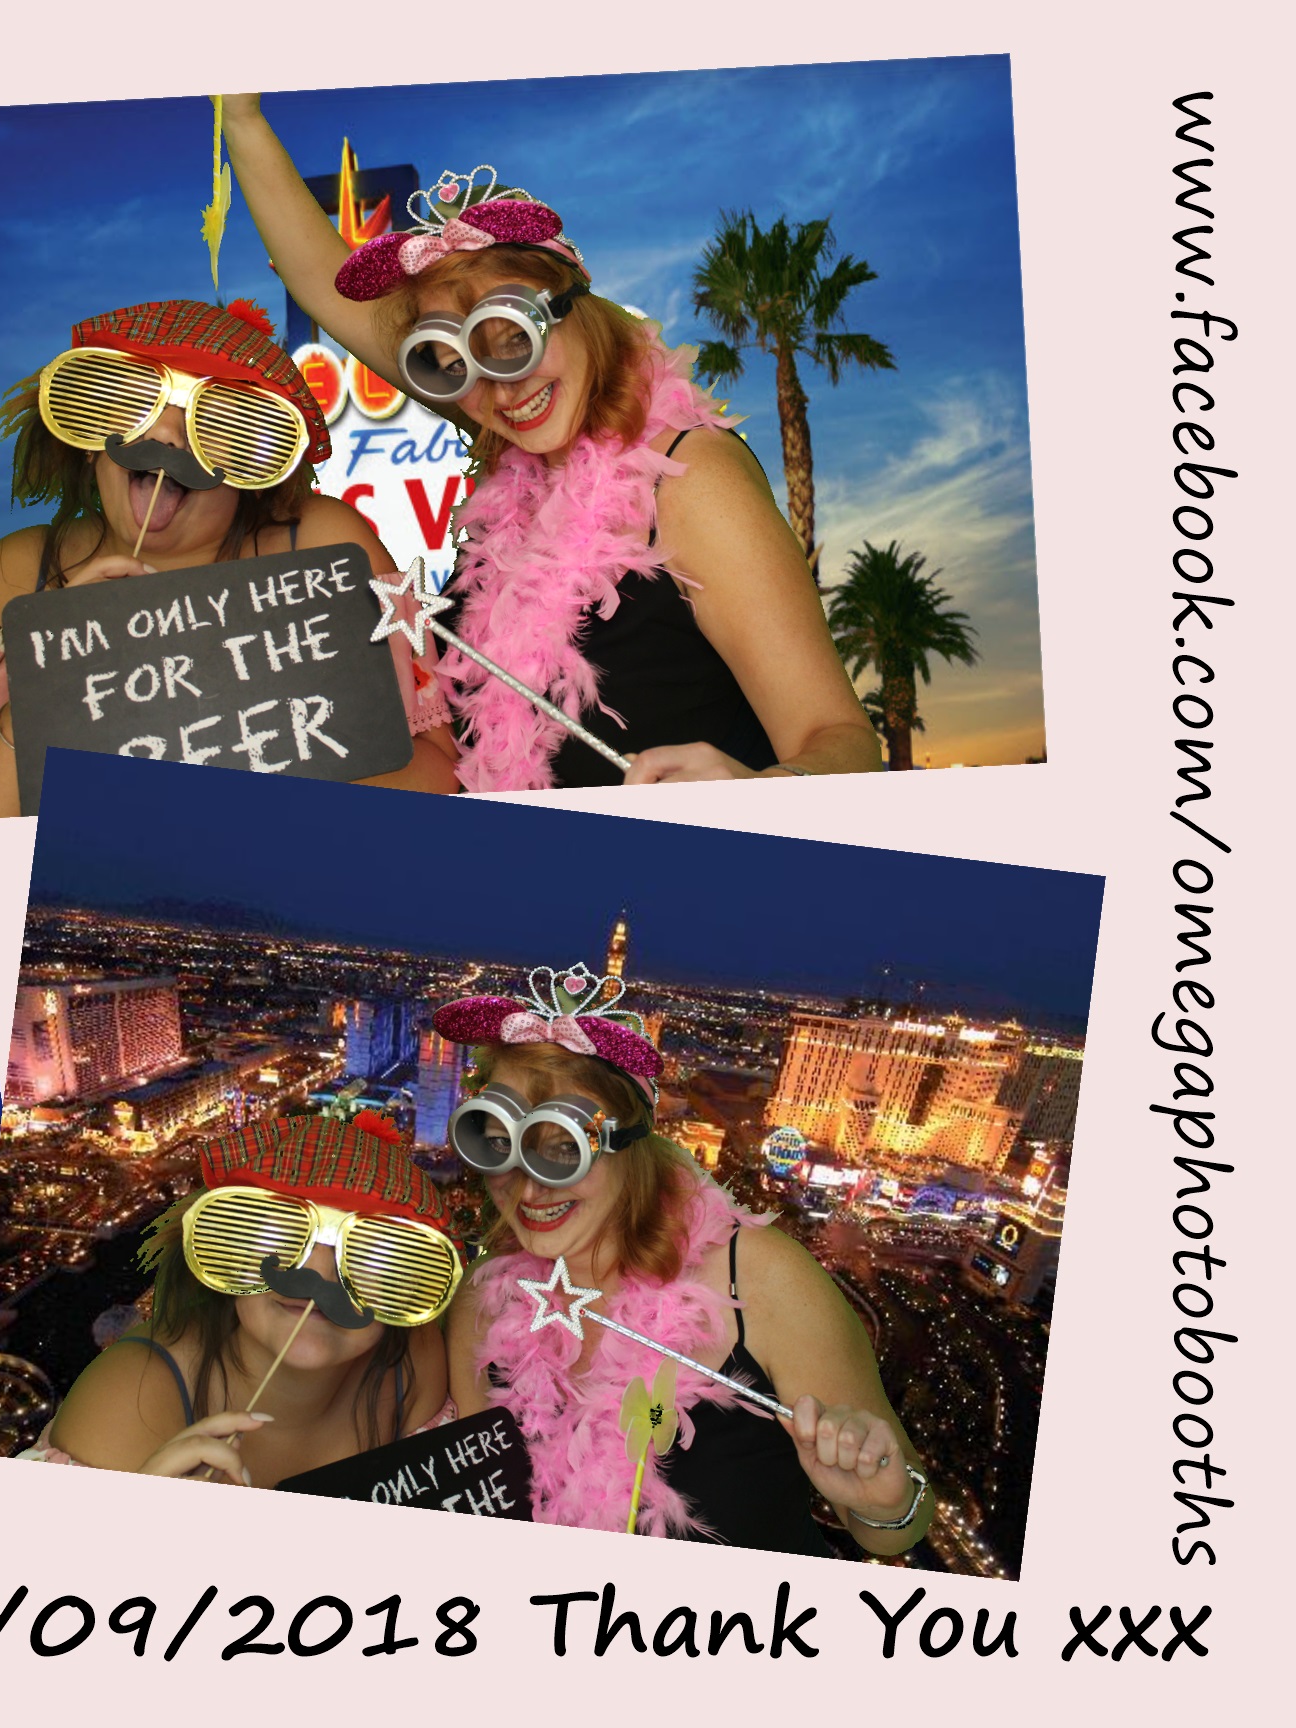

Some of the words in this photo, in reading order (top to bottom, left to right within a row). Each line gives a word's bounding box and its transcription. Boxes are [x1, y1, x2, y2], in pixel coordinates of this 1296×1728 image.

[30, 620, 110, 668] I'M
[127, 589, 229, 638] ONLY
[249, 557, 357, 613] HERE
[81, 655, 202, 721] FOR
[222, 614, 341, 681] THE
[371, 1456, 439, 1505] ONLY
[445, 1419, 512, 1474] HERE
